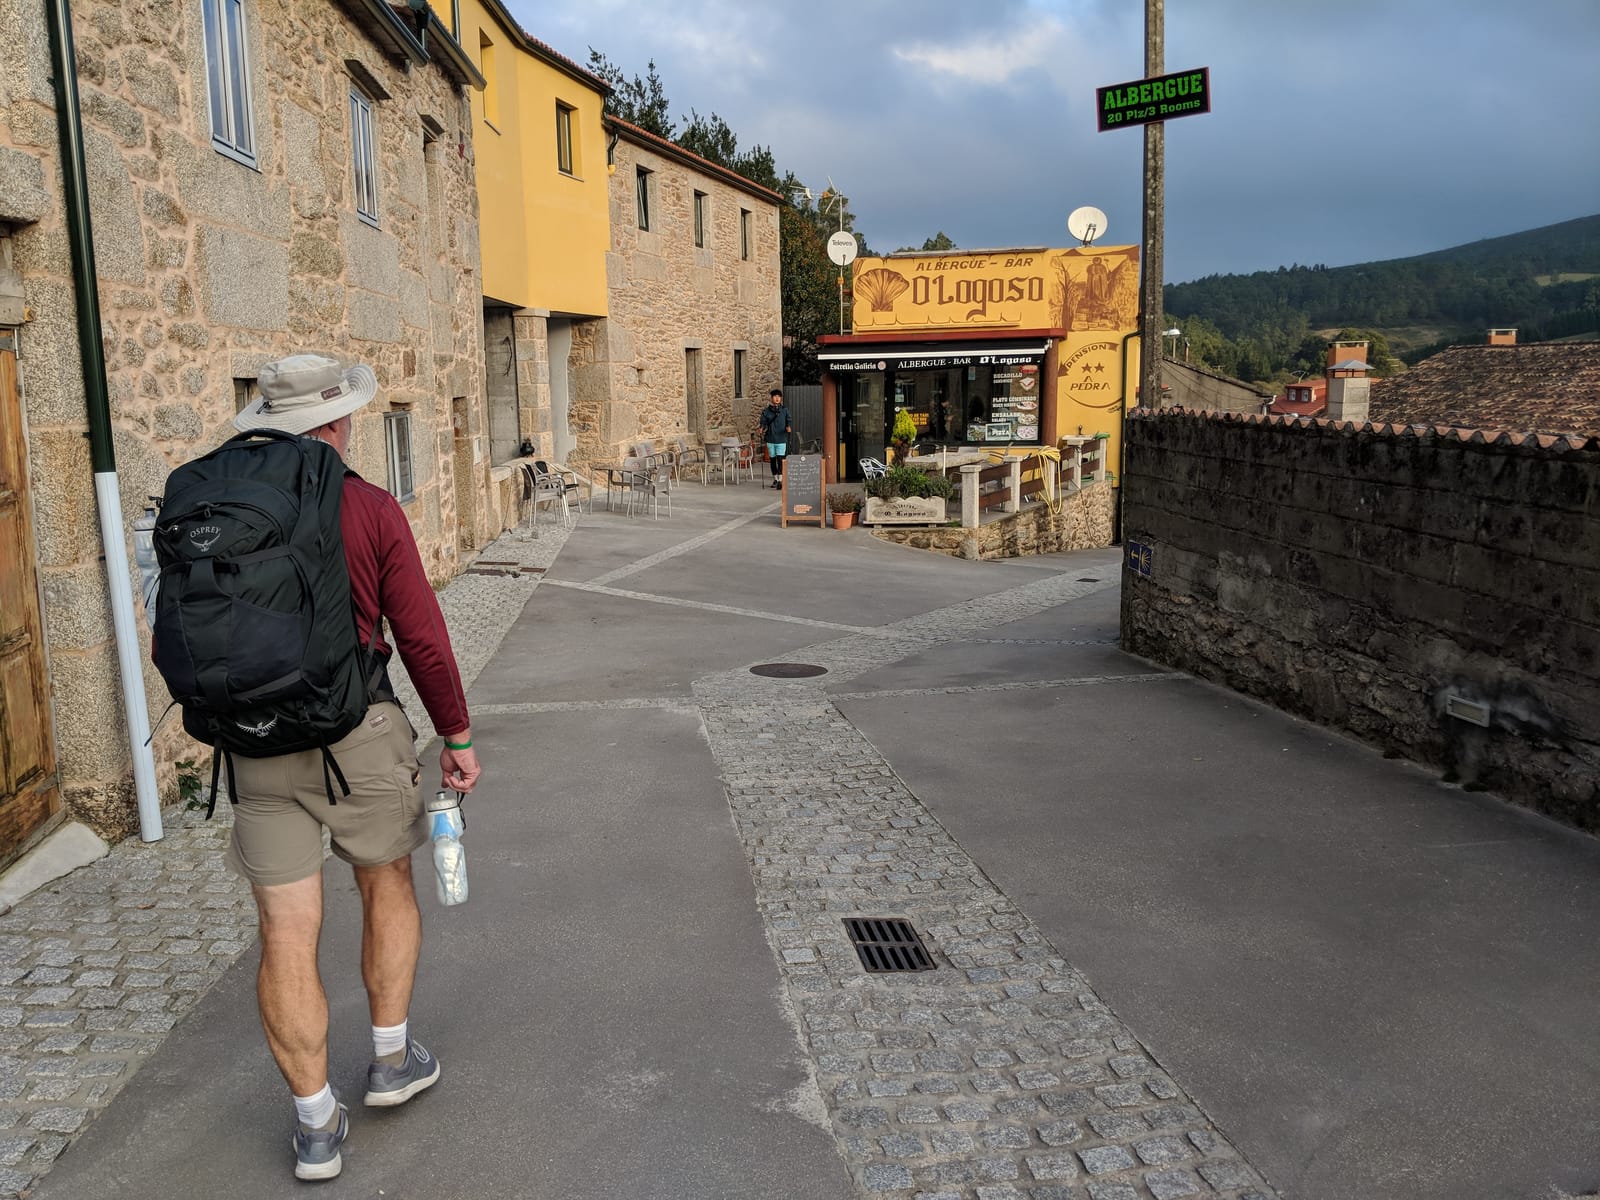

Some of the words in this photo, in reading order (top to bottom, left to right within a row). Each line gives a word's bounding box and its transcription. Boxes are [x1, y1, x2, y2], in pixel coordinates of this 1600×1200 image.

[1104, 74, 1203, 110] ALBERGUE
[1107, 113, 1122, 123] 20
[1126, 106, 1156, 120] Plz/3
[1160, 100, 1201, 114] Rooms
[916, 260, 986, 271] ALBERGUE
[1004, 258, 1034, 268] BAR
[1066, 344, 1107, 368] PENSION
[829, 362, 853, 370] Estrella
[854, 362, 876, 370] Galicia
[898, 359, 946, 369] ALBERGUE
[1070, 382, 1110, 390] PEDRA
[190, 526, 221, 538] OSPREY
